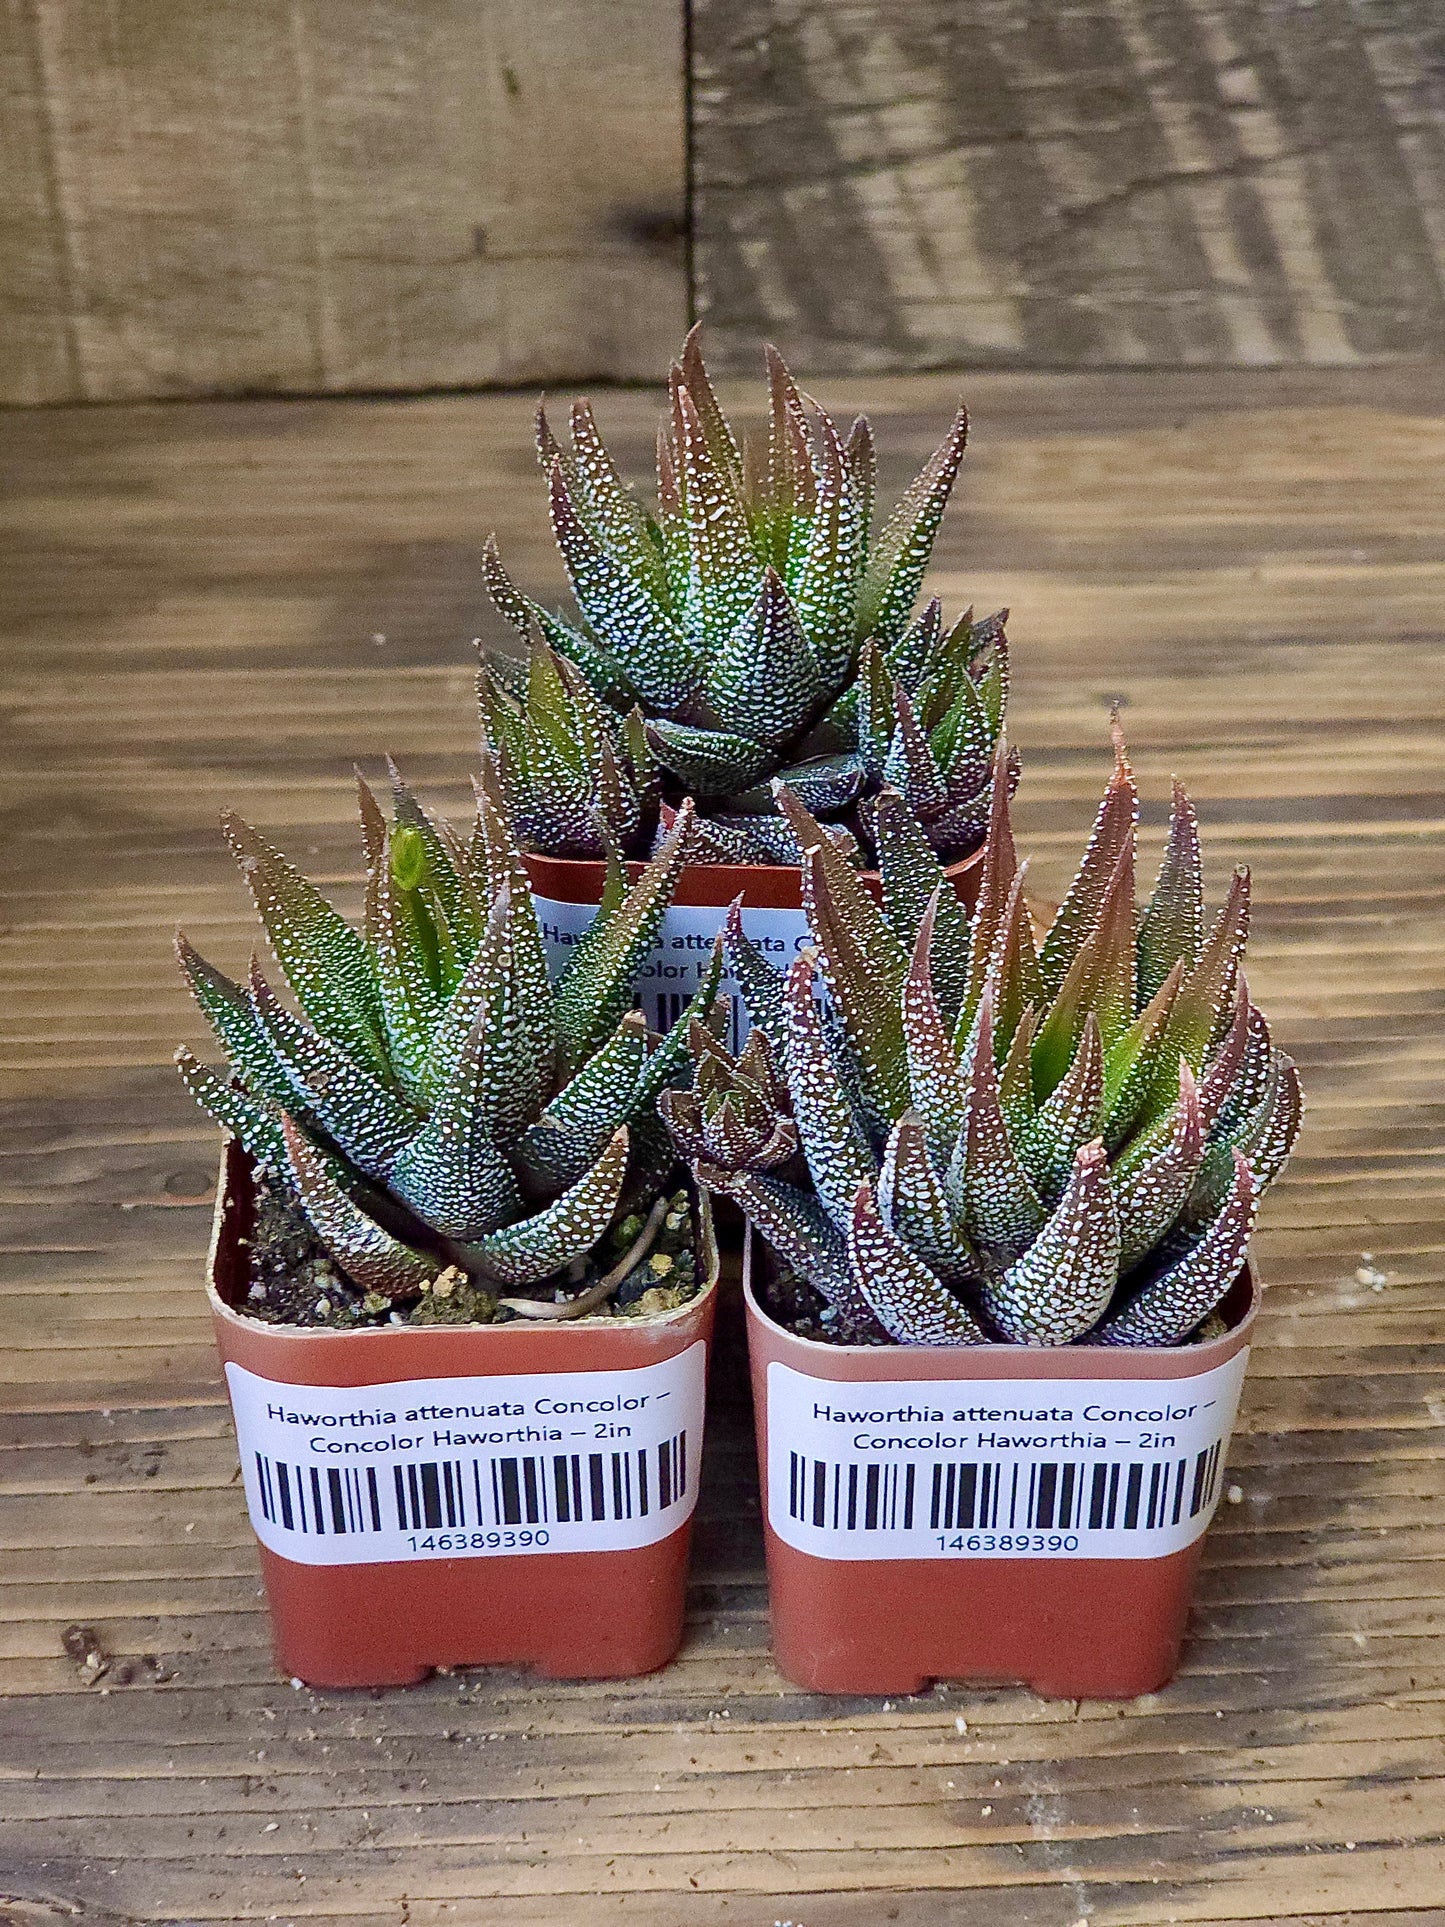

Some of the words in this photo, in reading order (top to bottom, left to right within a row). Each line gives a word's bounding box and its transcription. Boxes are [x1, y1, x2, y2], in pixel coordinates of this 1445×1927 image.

[671, 933, 785, 953] atteata
[266, 1403, 396, 1427] Haworthia
[404, 1402, 525, 1422] attenuata
[534, 1394, 650, 1415] Concolor
[813, 1402, 944, 1424] Haworthia
[952, 1406, 1074, 1422] attenuata
[1082, 1403, 1198, 1422] Concolor
[309, 1433, 425, 1454] Concolor
[432, 1425, 563, 1447] Haworthia
[594, 1422, 632, 1439] 2in
[853, 1431, 969, 1450] Concolor
[977, 1431, 1107, 1449] Haworthia
[1138, 1432, 1176, 1449] 2in
[406, 1529, 550, 1553] 146389390
[936, 1534, 1079, 1552] 146389390
